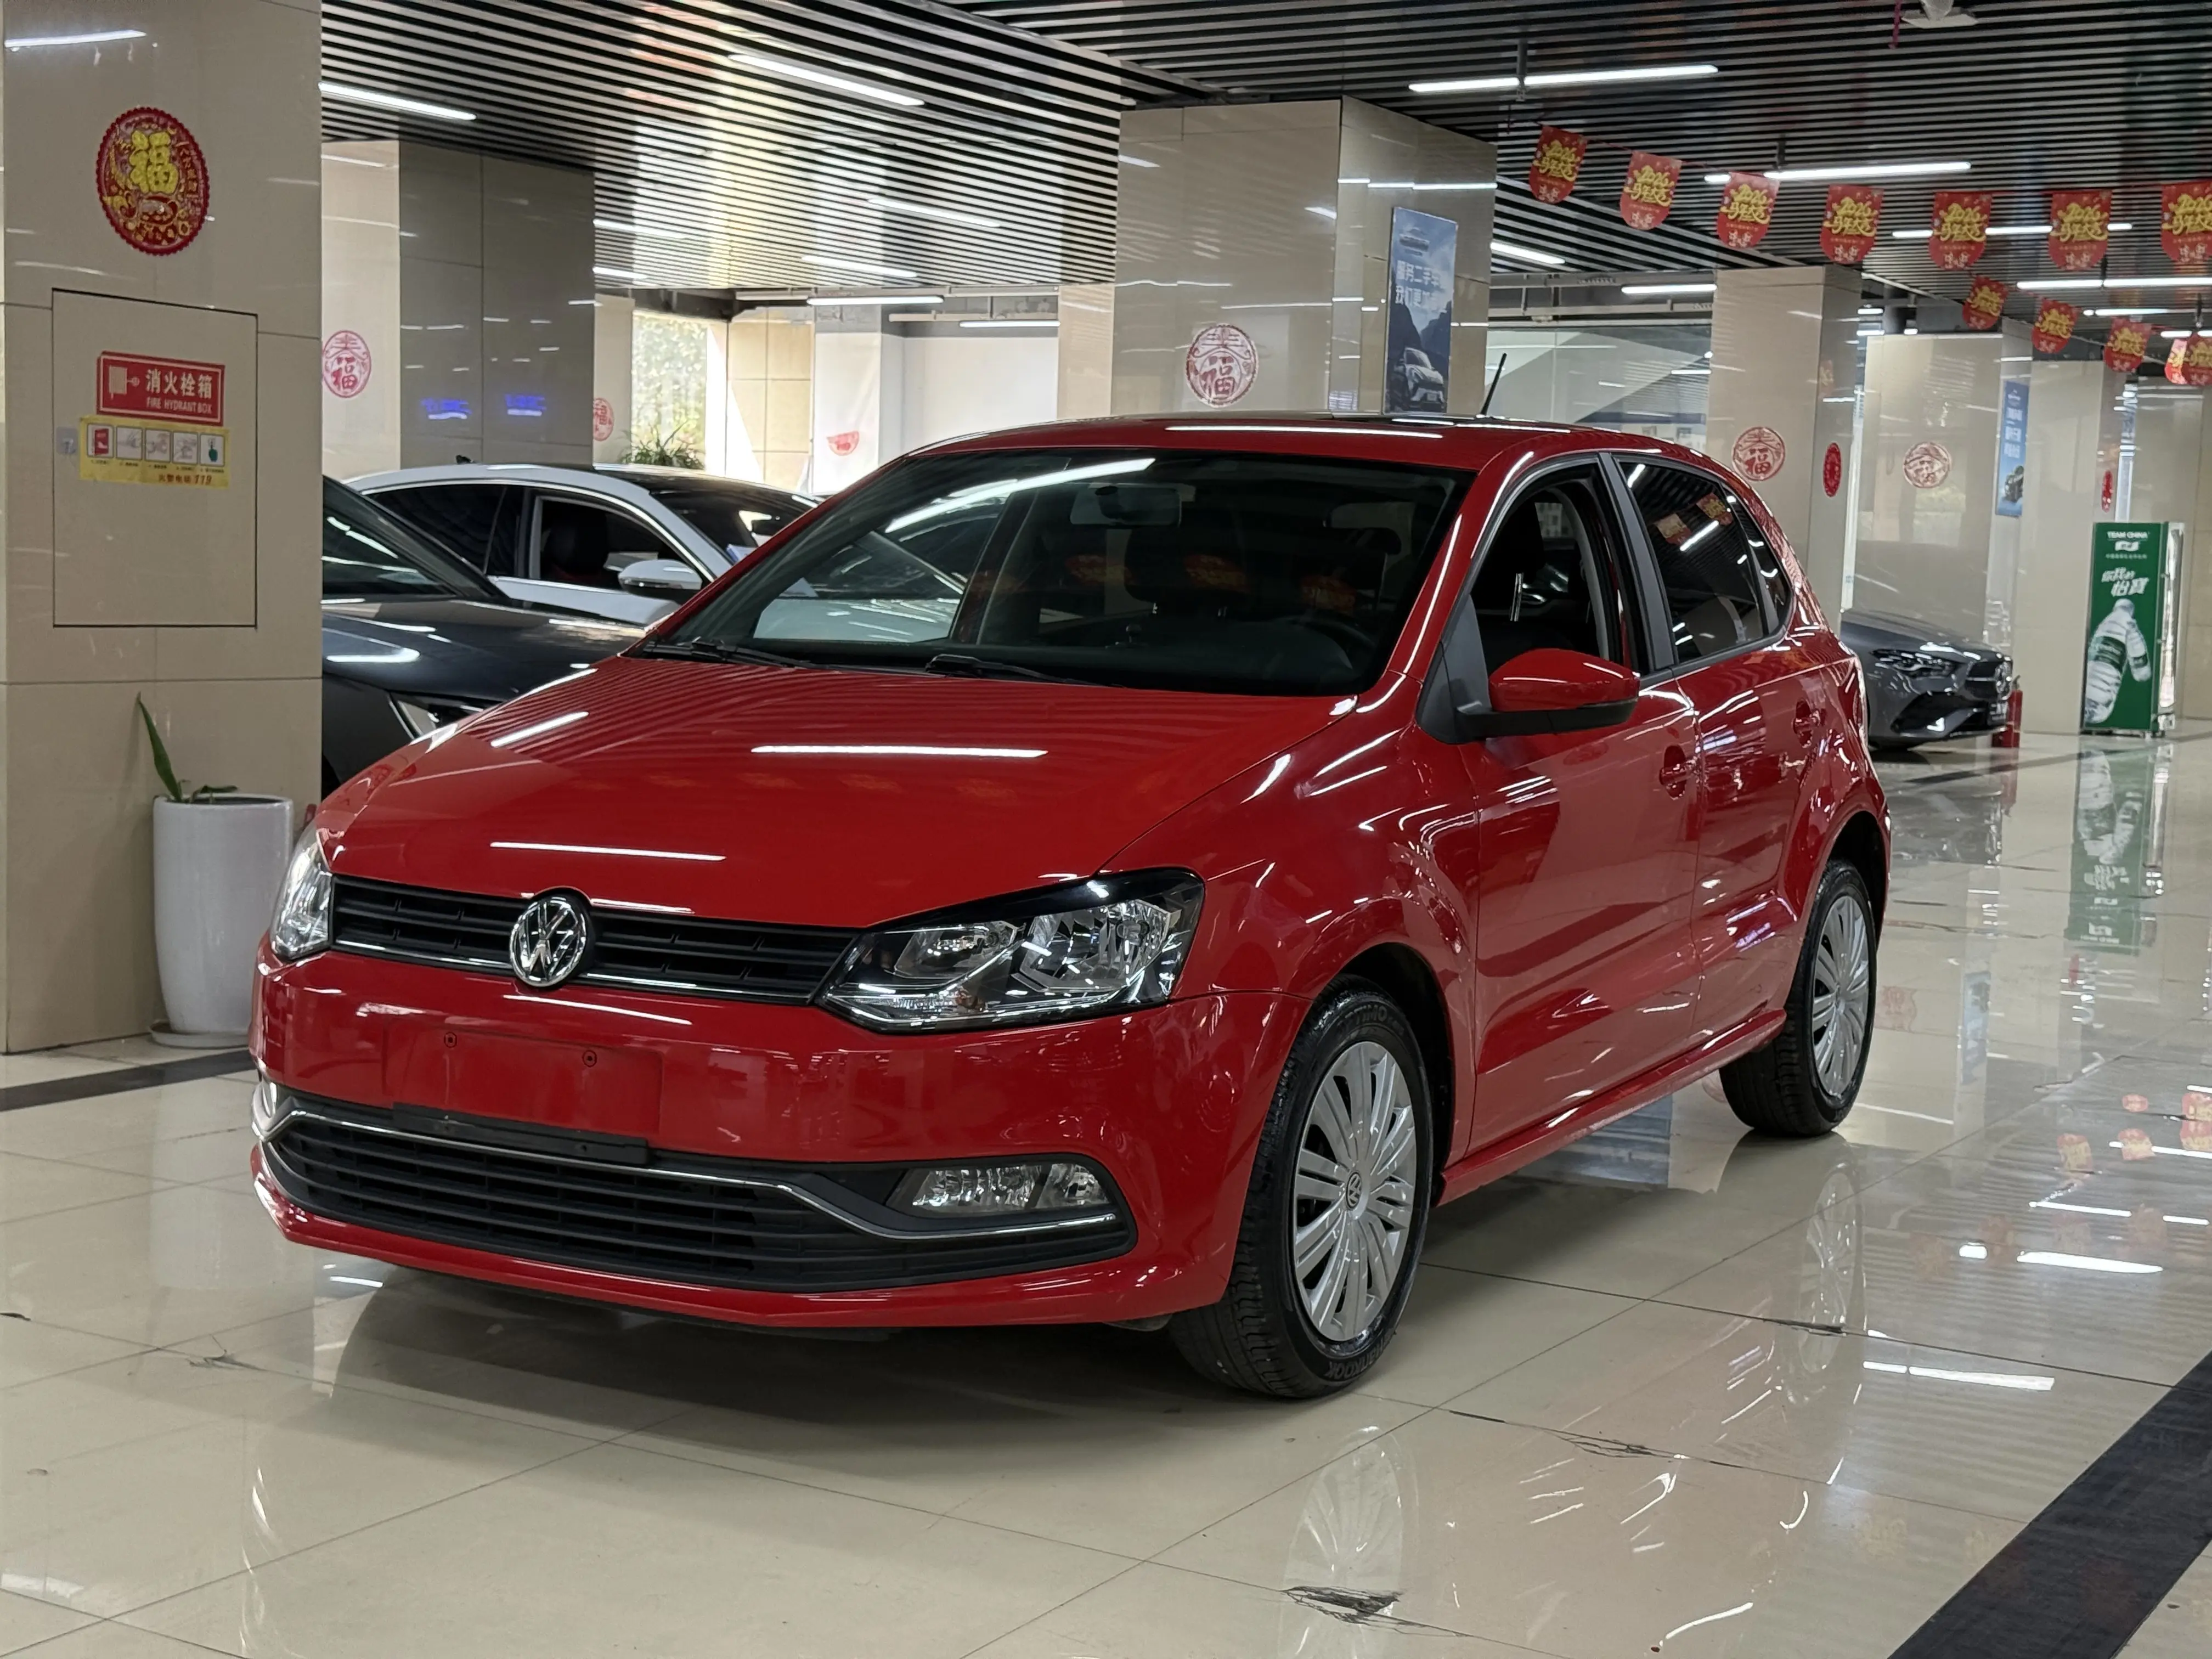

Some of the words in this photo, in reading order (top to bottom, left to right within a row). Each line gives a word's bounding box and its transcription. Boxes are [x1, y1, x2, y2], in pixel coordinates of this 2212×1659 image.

[129, 130, 179, 194] 福
[145, 368, 213, 399] 消火栓箱
[146, 397, 161, 409] FIRE
[164, 399, 196, 412] HYDRANT
[198, 403, 212, 414] BOX
[194, 474, 212, 485] 119
